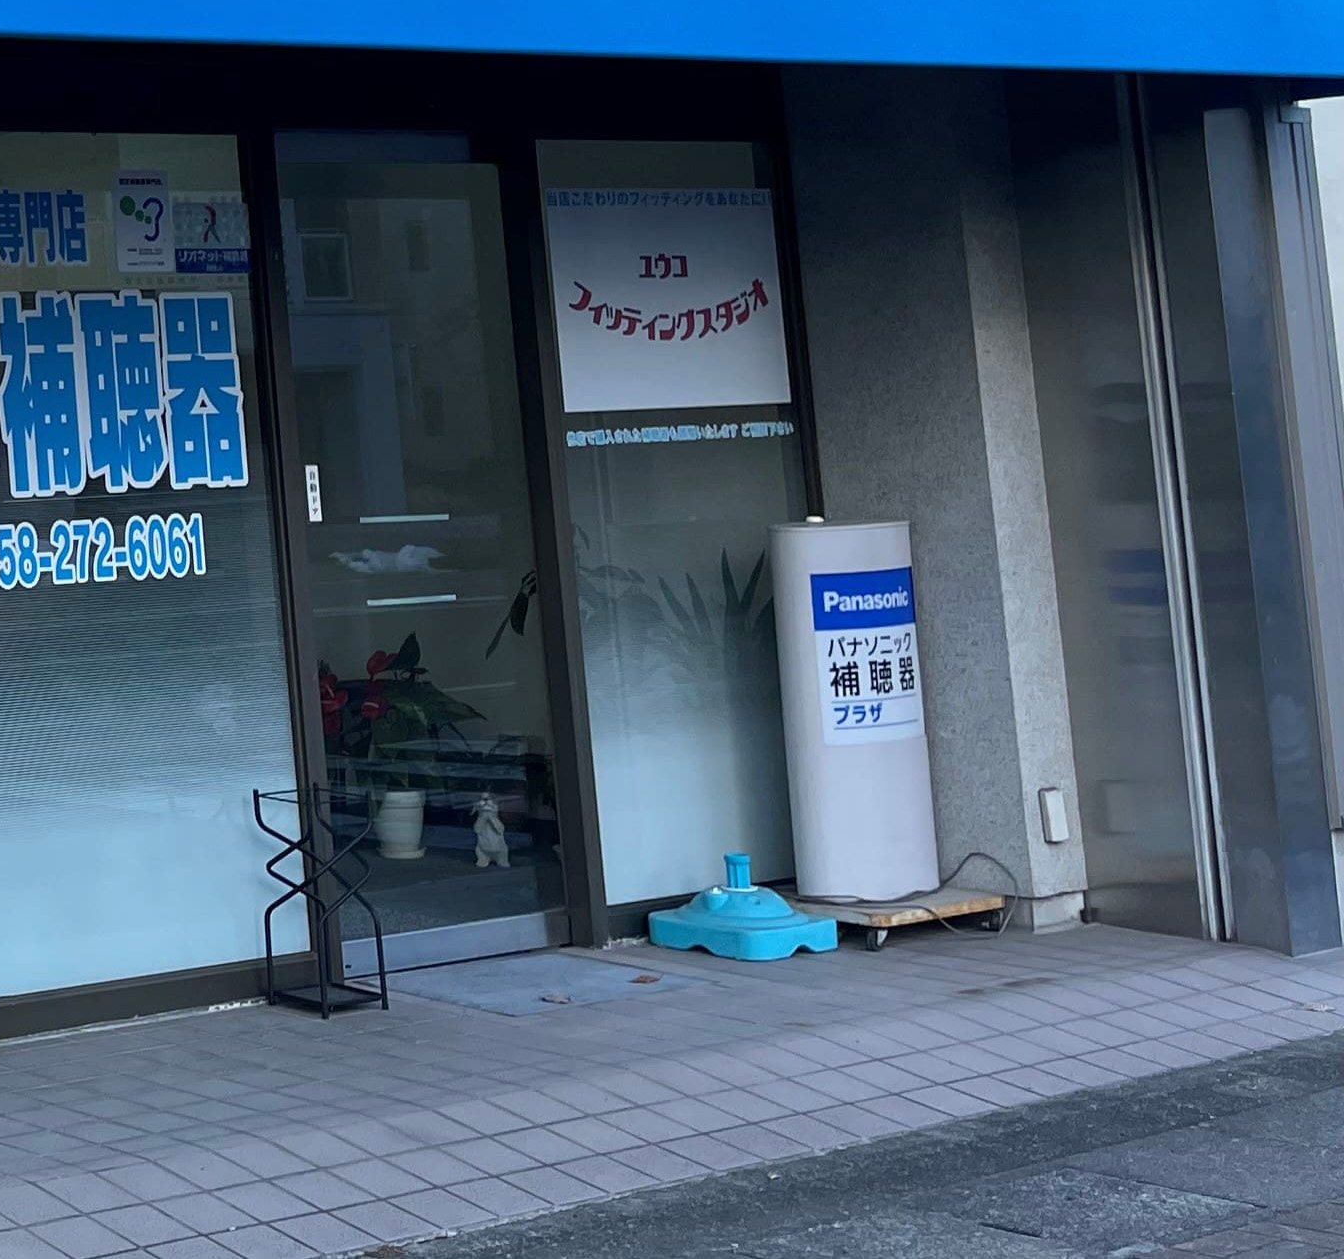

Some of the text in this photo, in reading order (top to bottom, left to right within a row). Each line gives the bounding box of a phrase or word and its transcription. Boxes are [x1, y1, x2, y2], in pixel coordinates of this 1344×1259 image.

[638, 253, 689, 279] ユウコ
[568, 278, 769, 341] フィッティングスタジオ
[823, 586, 909, 613] Panasonic
[828, 632, 912, 658] パナソニック
[829, 655, 915, 699] 補聴器
[833, 702, 883, 726] プラザ
